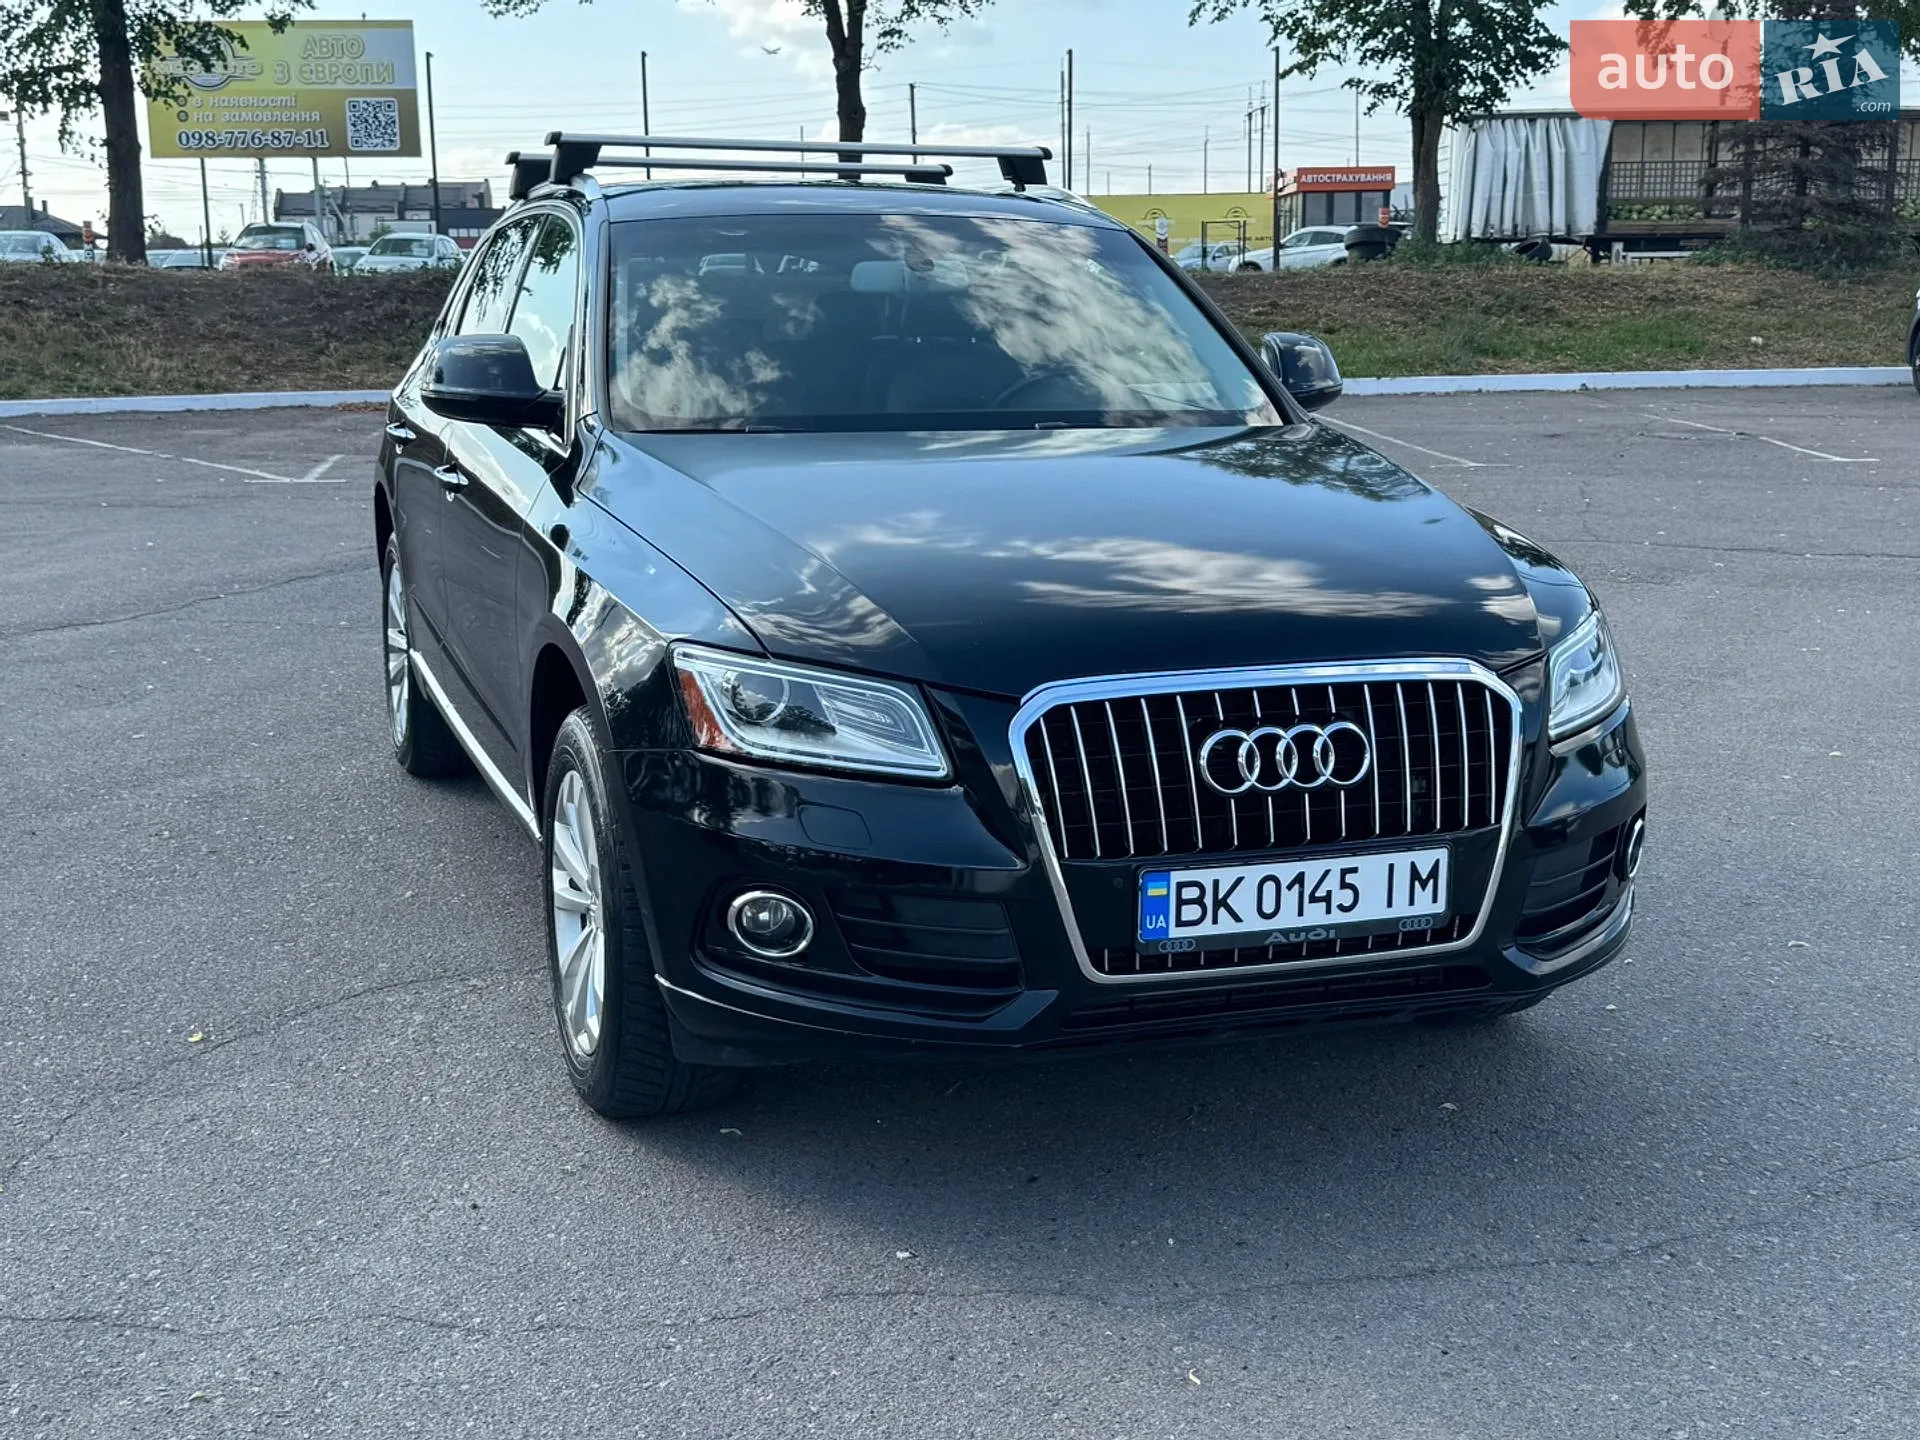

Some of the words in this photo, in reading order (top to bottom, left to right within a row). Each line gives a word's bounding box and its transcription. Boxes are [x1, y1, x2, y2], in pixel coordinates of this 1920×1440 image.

[301, 35, 365, 59] АВТО
[274, 61, 290, 84] З
[299, 61, 395, 84] ЄВРОПИ
[210, 92, 298, 108] наявності
[193, 111, 216, 123] на
[221, 111, 322, 123] замовлення
[177, 129, 329, 149] 098-776-87-11
[1300, 173, 1393, 183] АВТОСТРАХУВАННЯ
[1174, 876, 1245, 928] BK
[1256, 866, 1360, 920] 0145
[1386, 857, 1441, 908] IM
[1146, 915, 1166, 929] UA
[1264, 929, 1337, 945] Audi
